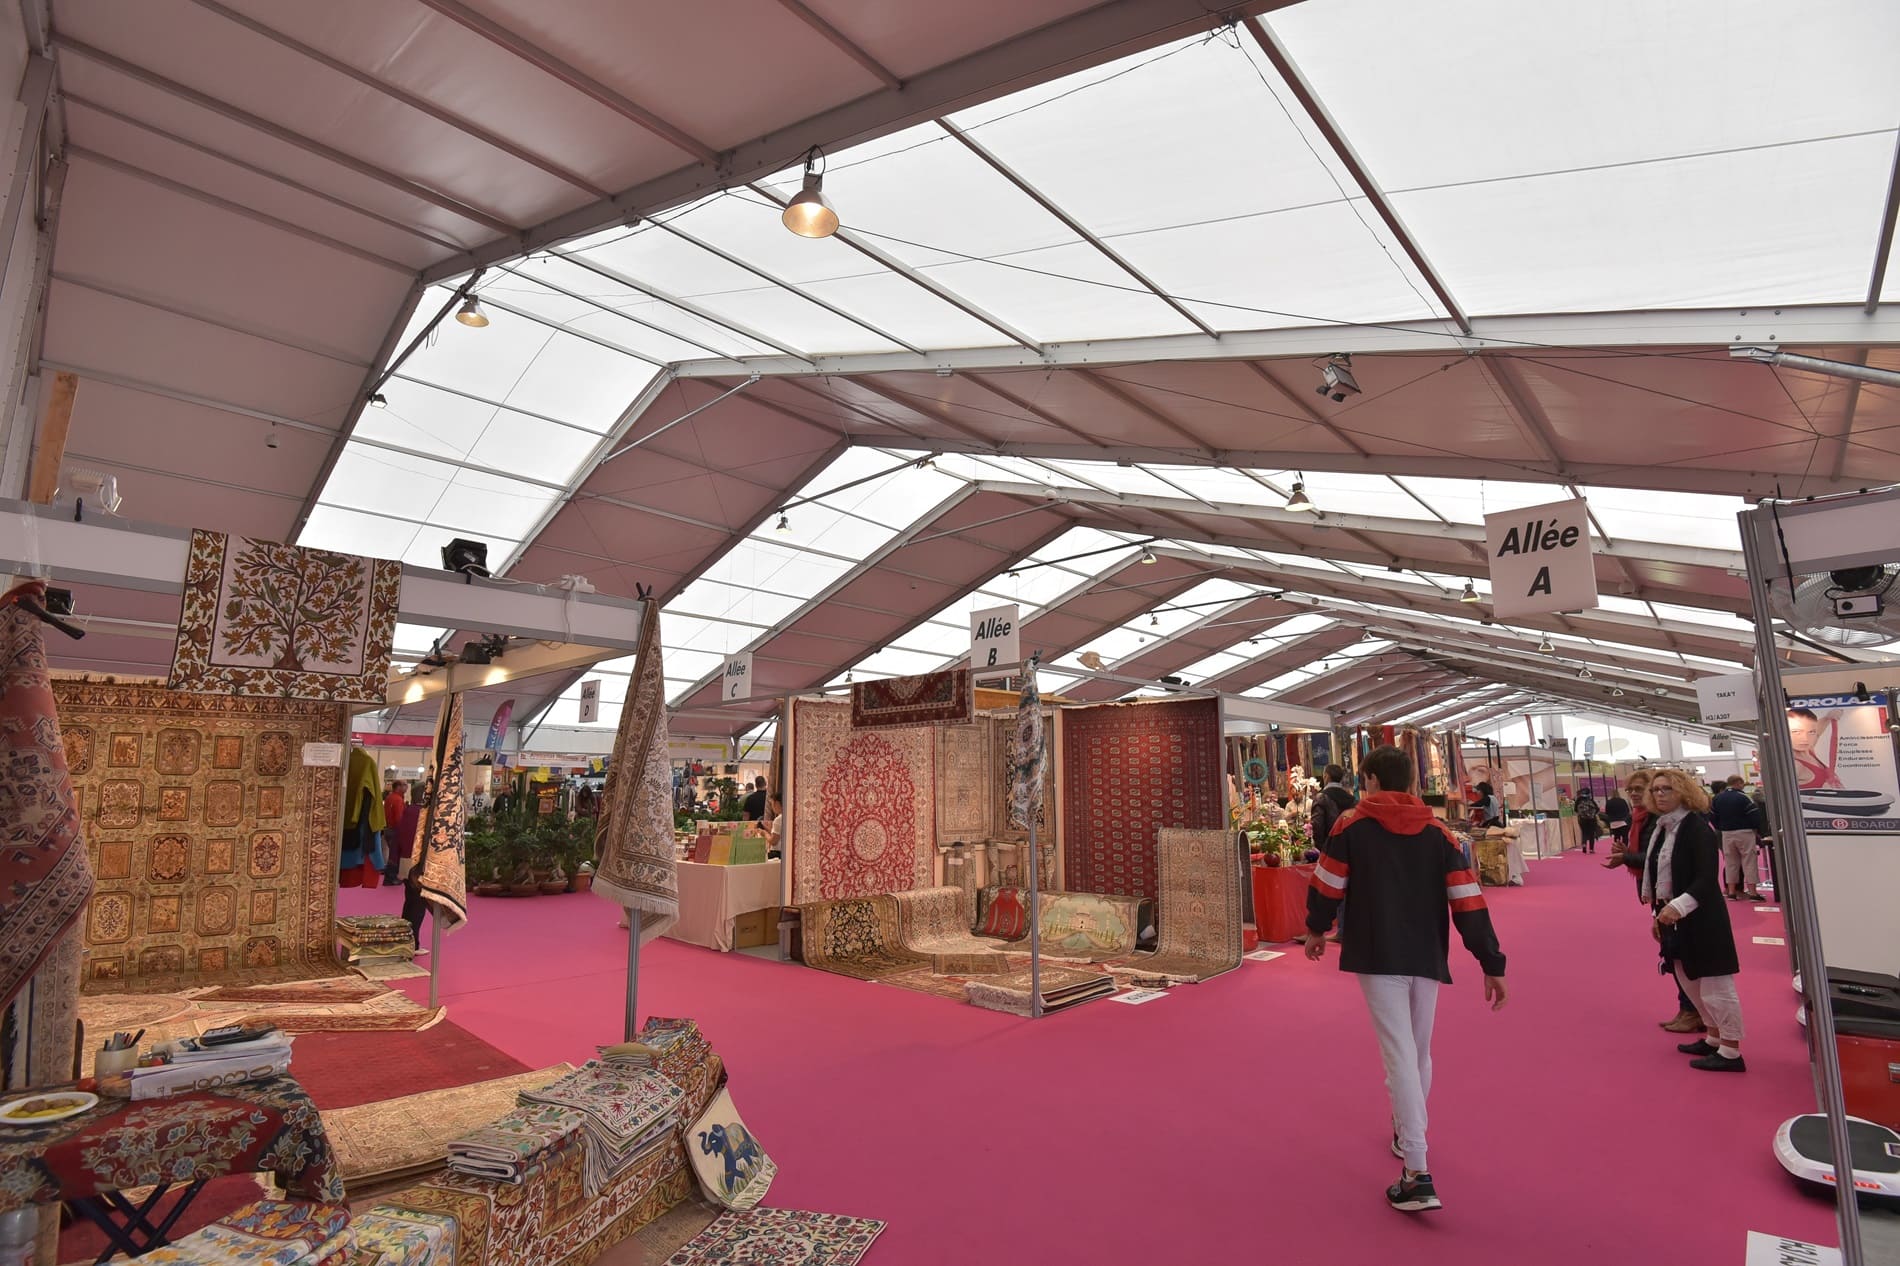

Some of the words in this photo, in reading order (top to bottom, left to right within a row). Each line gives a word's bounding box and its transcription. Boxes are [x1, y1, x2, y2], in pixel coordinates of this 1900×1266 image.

[1497, 519, 1579, 557] Allée
[1527, 566, 1551, 597] A
[974, 617, 1011, 640] Allée
[987, 648, 997, 666] B
[725, 661, 746, 677] Allée
[583, 688, 596, 699] Allée
[731, 683, 738, 698] C
[1789, 695, 1877, 708] DROLAX
[1805, 820, 1830, 829] WER
[1851, 820, 1896, 829] BOARD
